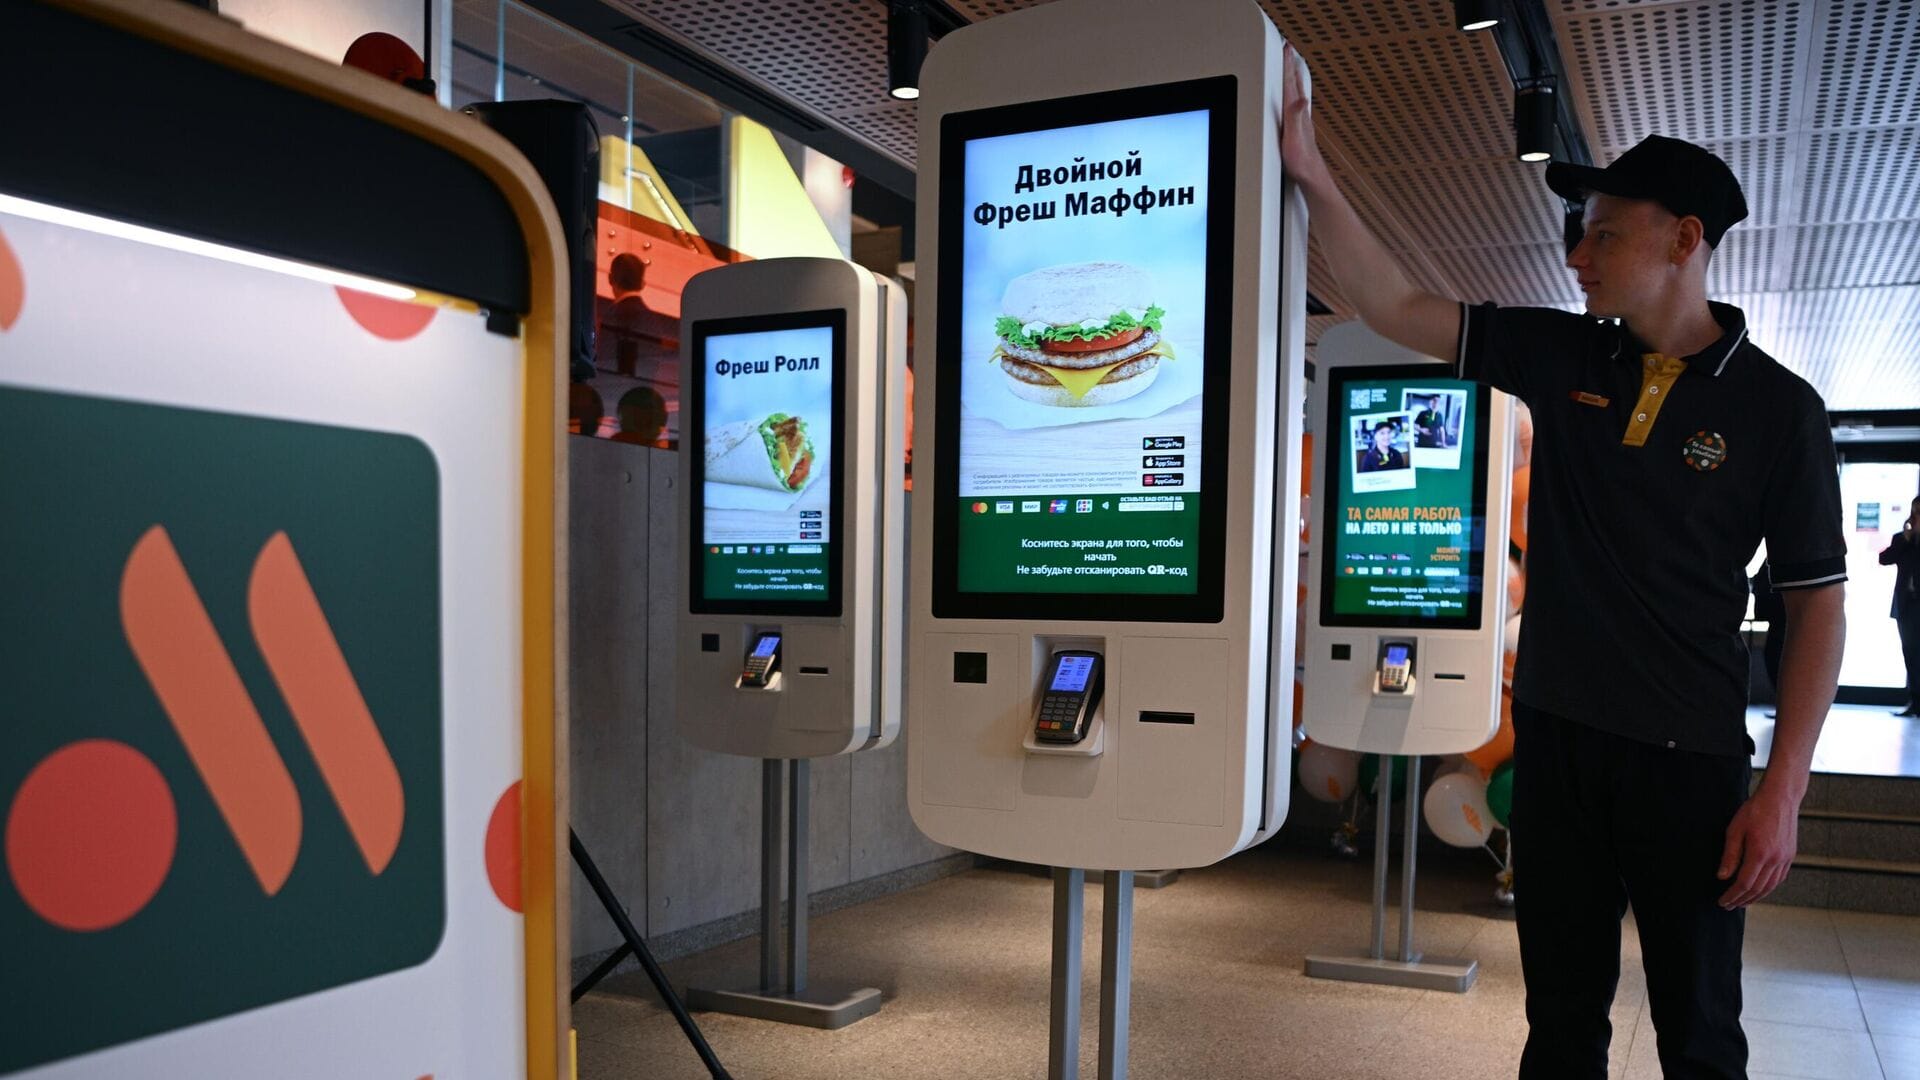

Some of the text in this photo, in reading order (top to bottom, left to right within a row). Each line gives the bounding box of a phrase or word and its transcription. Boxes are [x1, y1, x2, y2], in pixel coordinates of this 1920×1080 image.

[1015, 150, 1142, 193] Двойной
[973, 185, 1194, 229] Фреш Маффин
[715, 355, 820, 379] Фреш Ролл
[1347, 507, 1461, 521] ТА САМАЯ РАБОТА
[1345, 522, 1462, 535] НА ЛЕТО И НЕ ТОЛЬКО
[1021, 537, 1184, 550] Коснитесь экрана для того, чтобы
[1084, 553, 1117, 561] начать
[1016, 565, 1188, 577] Не забудьте отсканировать QR-код
